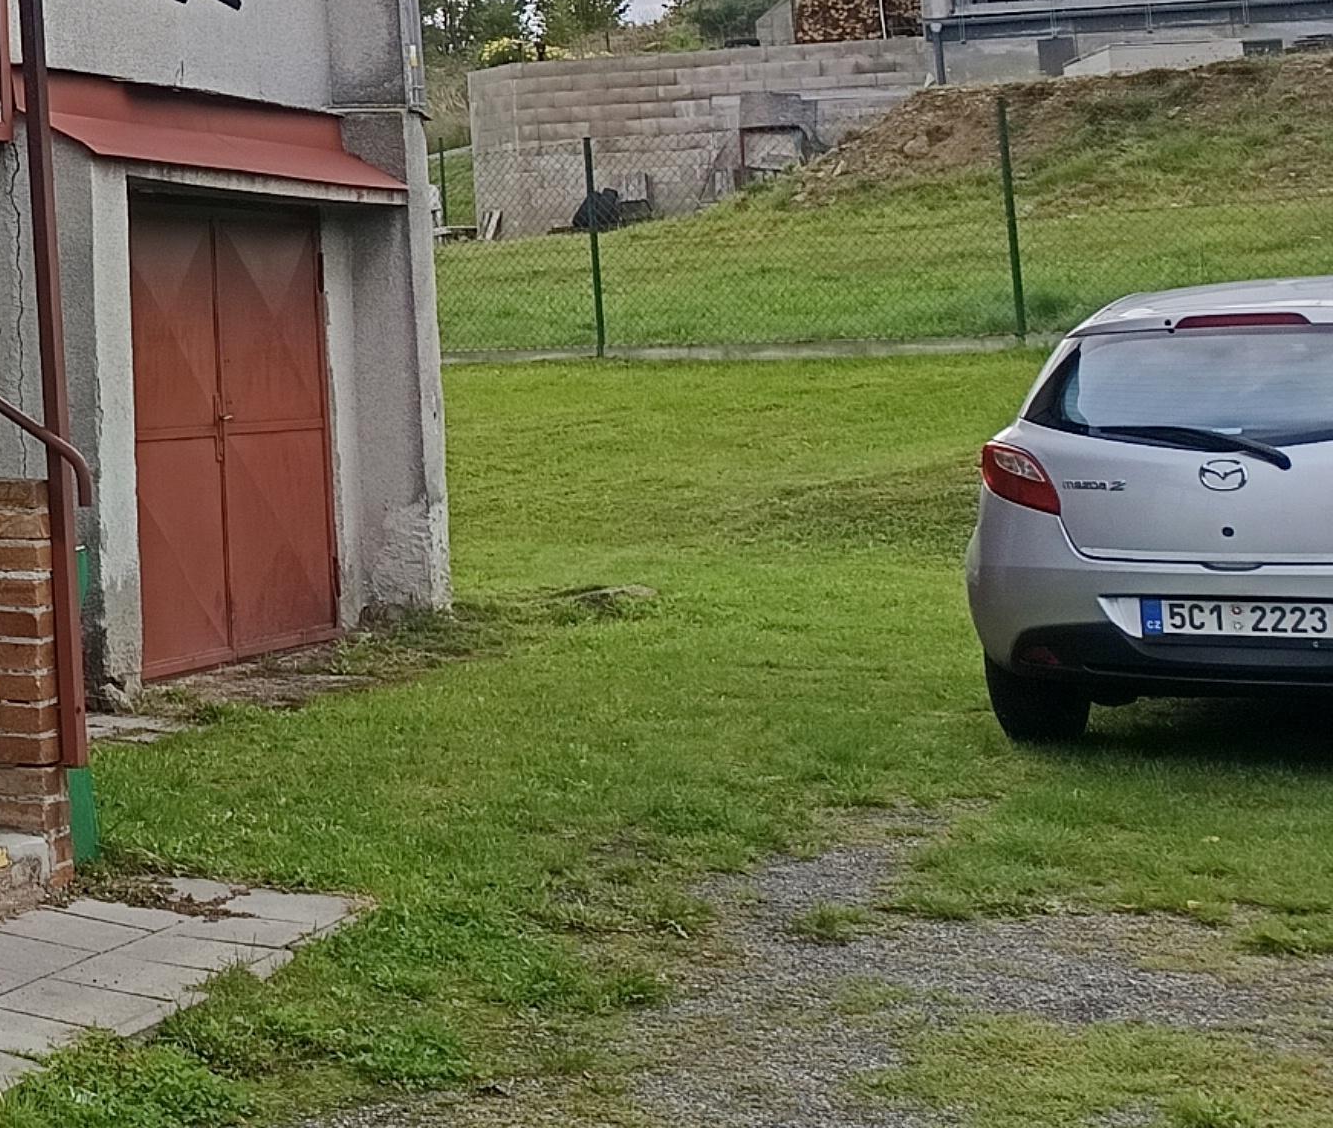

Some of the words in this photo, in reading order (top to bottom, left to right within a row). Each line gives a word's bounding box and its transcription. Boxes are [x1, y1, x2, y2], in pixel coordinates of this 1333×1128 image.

[1146, 620, 1161, 629] CZ
[1168, 604, 1224, 631] 5C1
[1250, 605, 1328, 633] 2223
